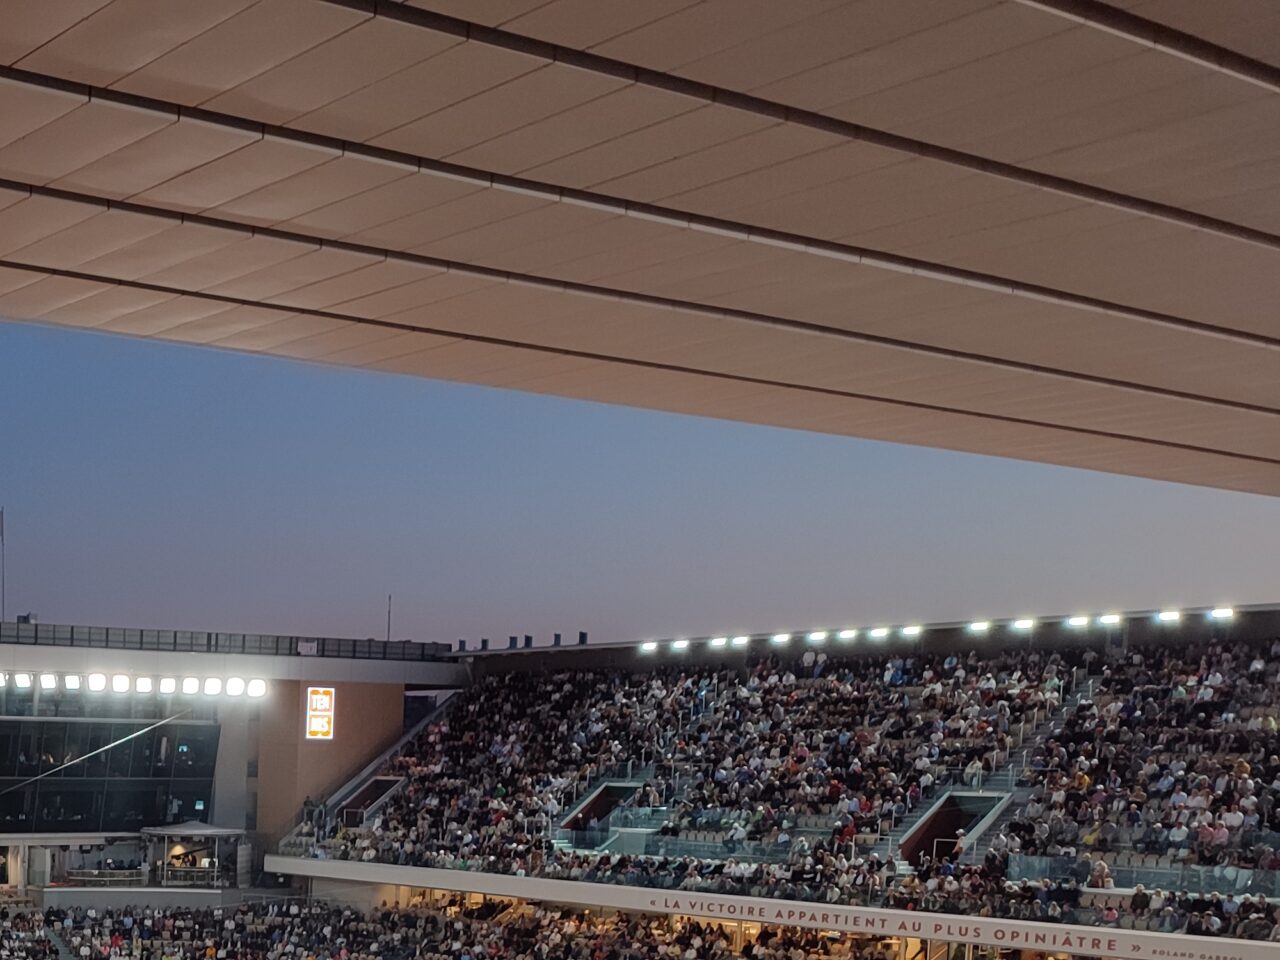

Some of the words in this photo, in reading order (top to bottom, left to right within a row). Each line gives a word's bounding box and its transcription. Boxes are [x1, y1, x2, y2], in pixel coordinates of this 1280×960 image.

[664, 898, 681, 909] LA
[689, 901, 765, 917] VICTOIRE
[775, 910, 888, 929] APPARTIENT
[898, 921, 921, 932] AU
[934, 923, 981, 938] PLUS
[994, 929, 1117, 951] OPINIÂTRE
[1151, 949, 1195, 959] ROLAND
